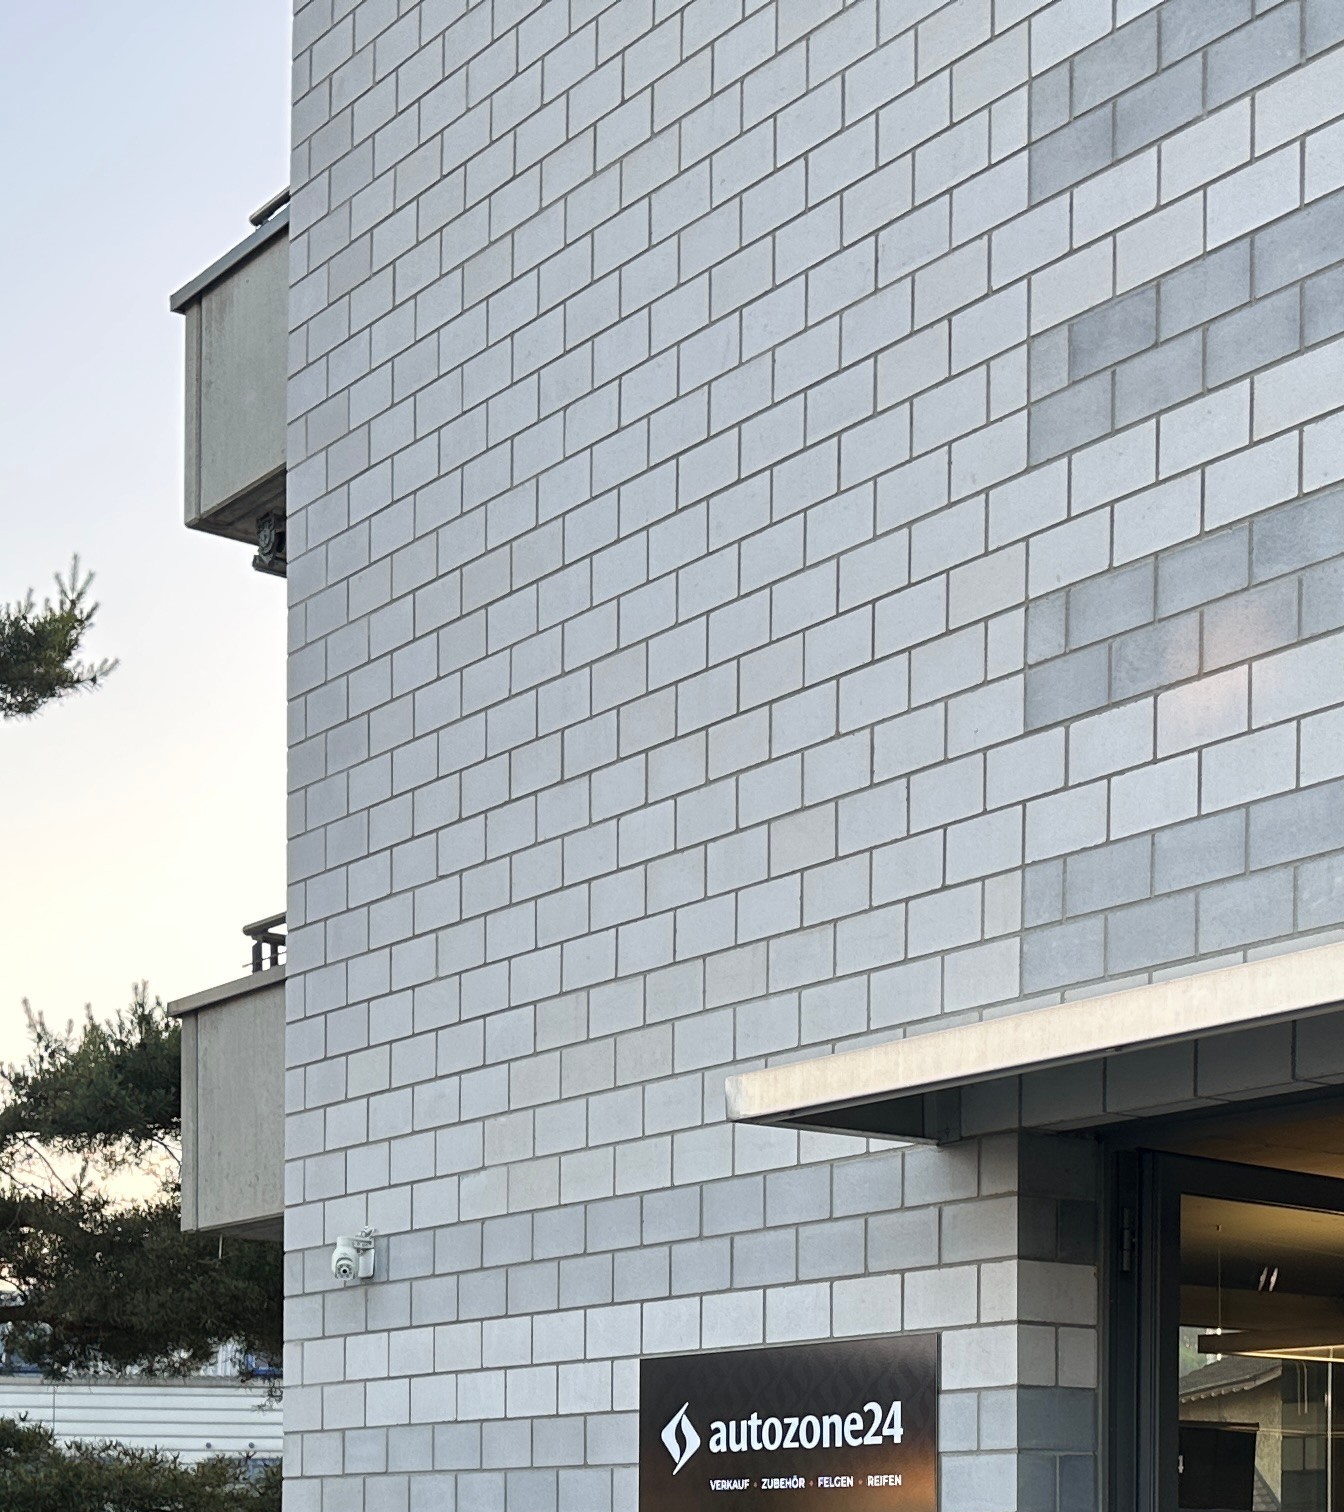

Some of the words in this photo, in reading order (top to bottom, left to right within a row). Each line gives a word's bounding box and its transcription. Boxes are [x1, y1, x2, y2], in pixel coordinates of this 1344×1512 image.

[709, 1401, 904, 1454] autozone24
[710, 1478, 750, 1491] VERKAUF
[761, 1474, 806, 1490] ZUBEHÖR
[817, 1475, 854, 1488] FELGEN
[867, 1474, 902, 1487] REIFEN
